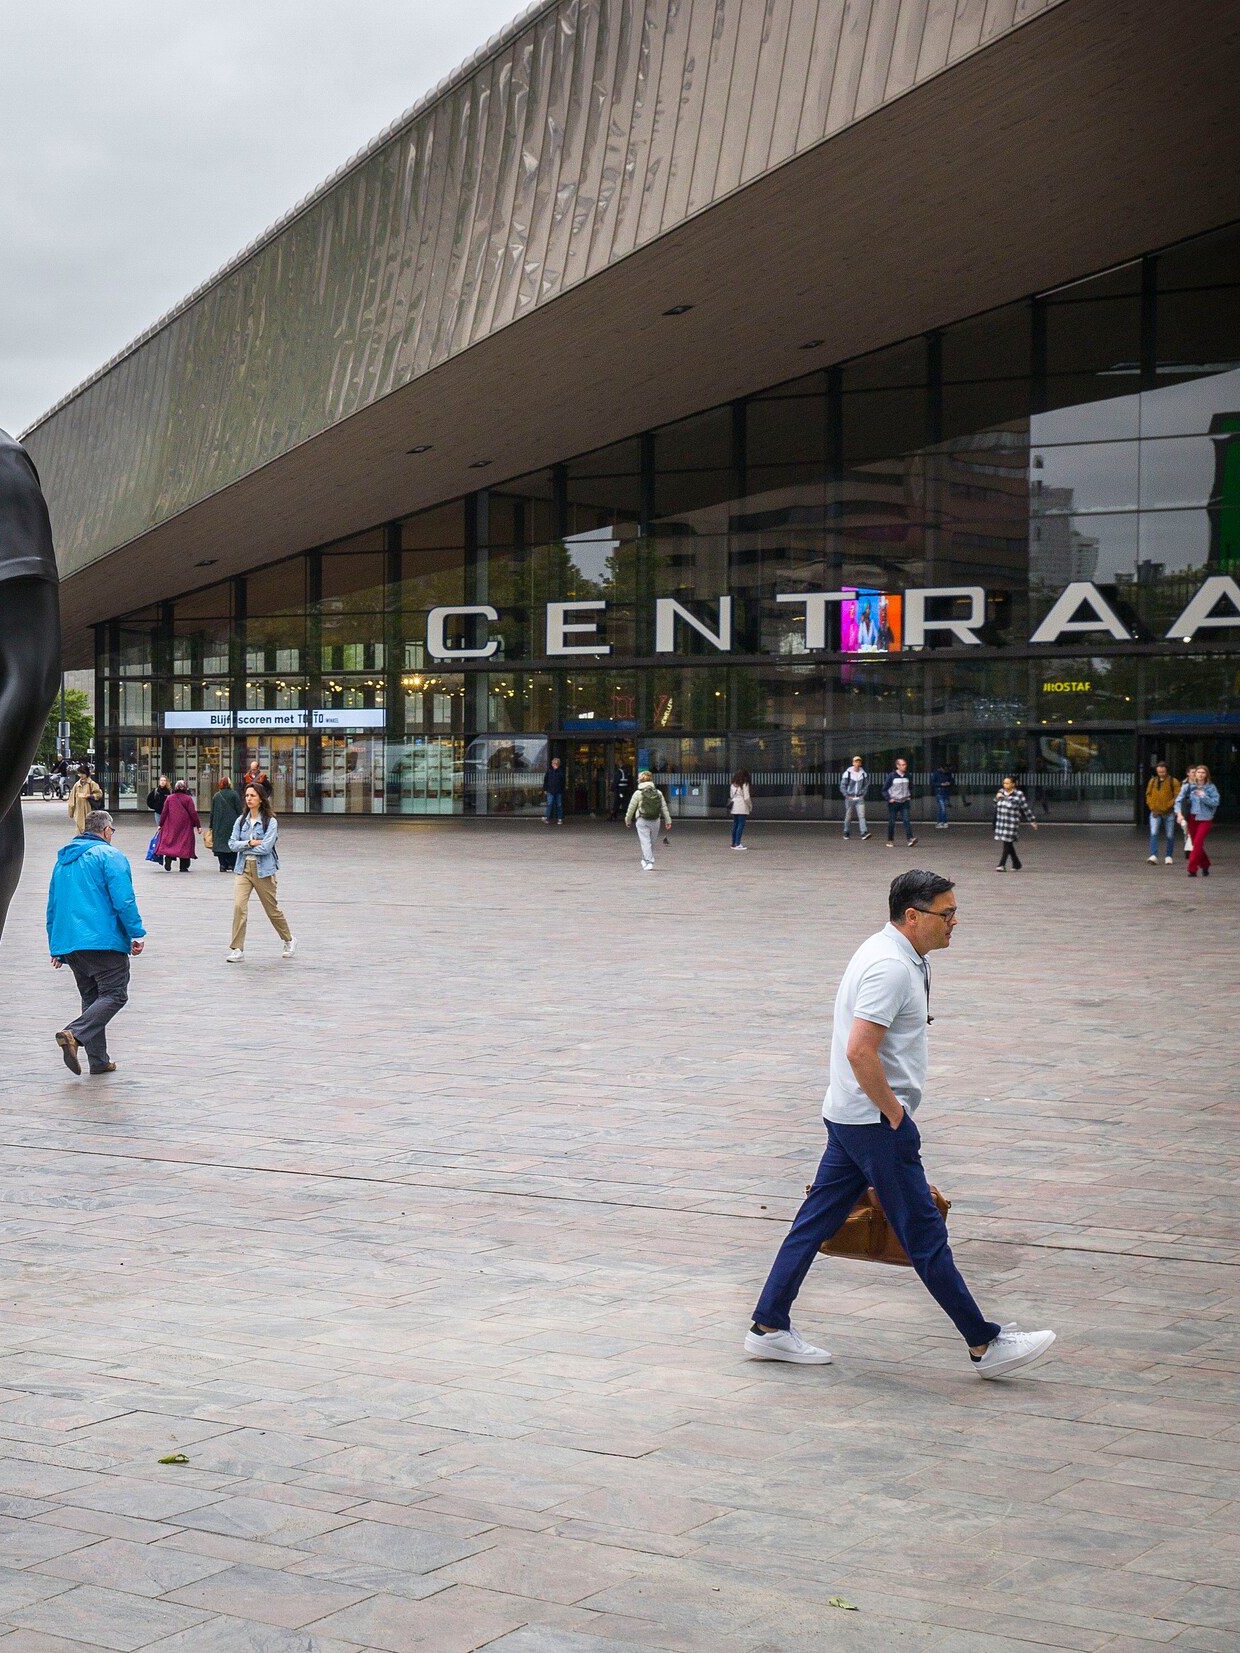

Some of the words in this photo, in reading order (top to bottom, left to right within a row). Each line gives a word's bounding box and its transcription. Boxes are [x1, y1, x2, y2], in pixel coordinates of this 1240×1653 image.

[210, 714, 231, 726] Blijf
[238, 716, 272, 724] scoren
[274, 714, 294, 724] met
